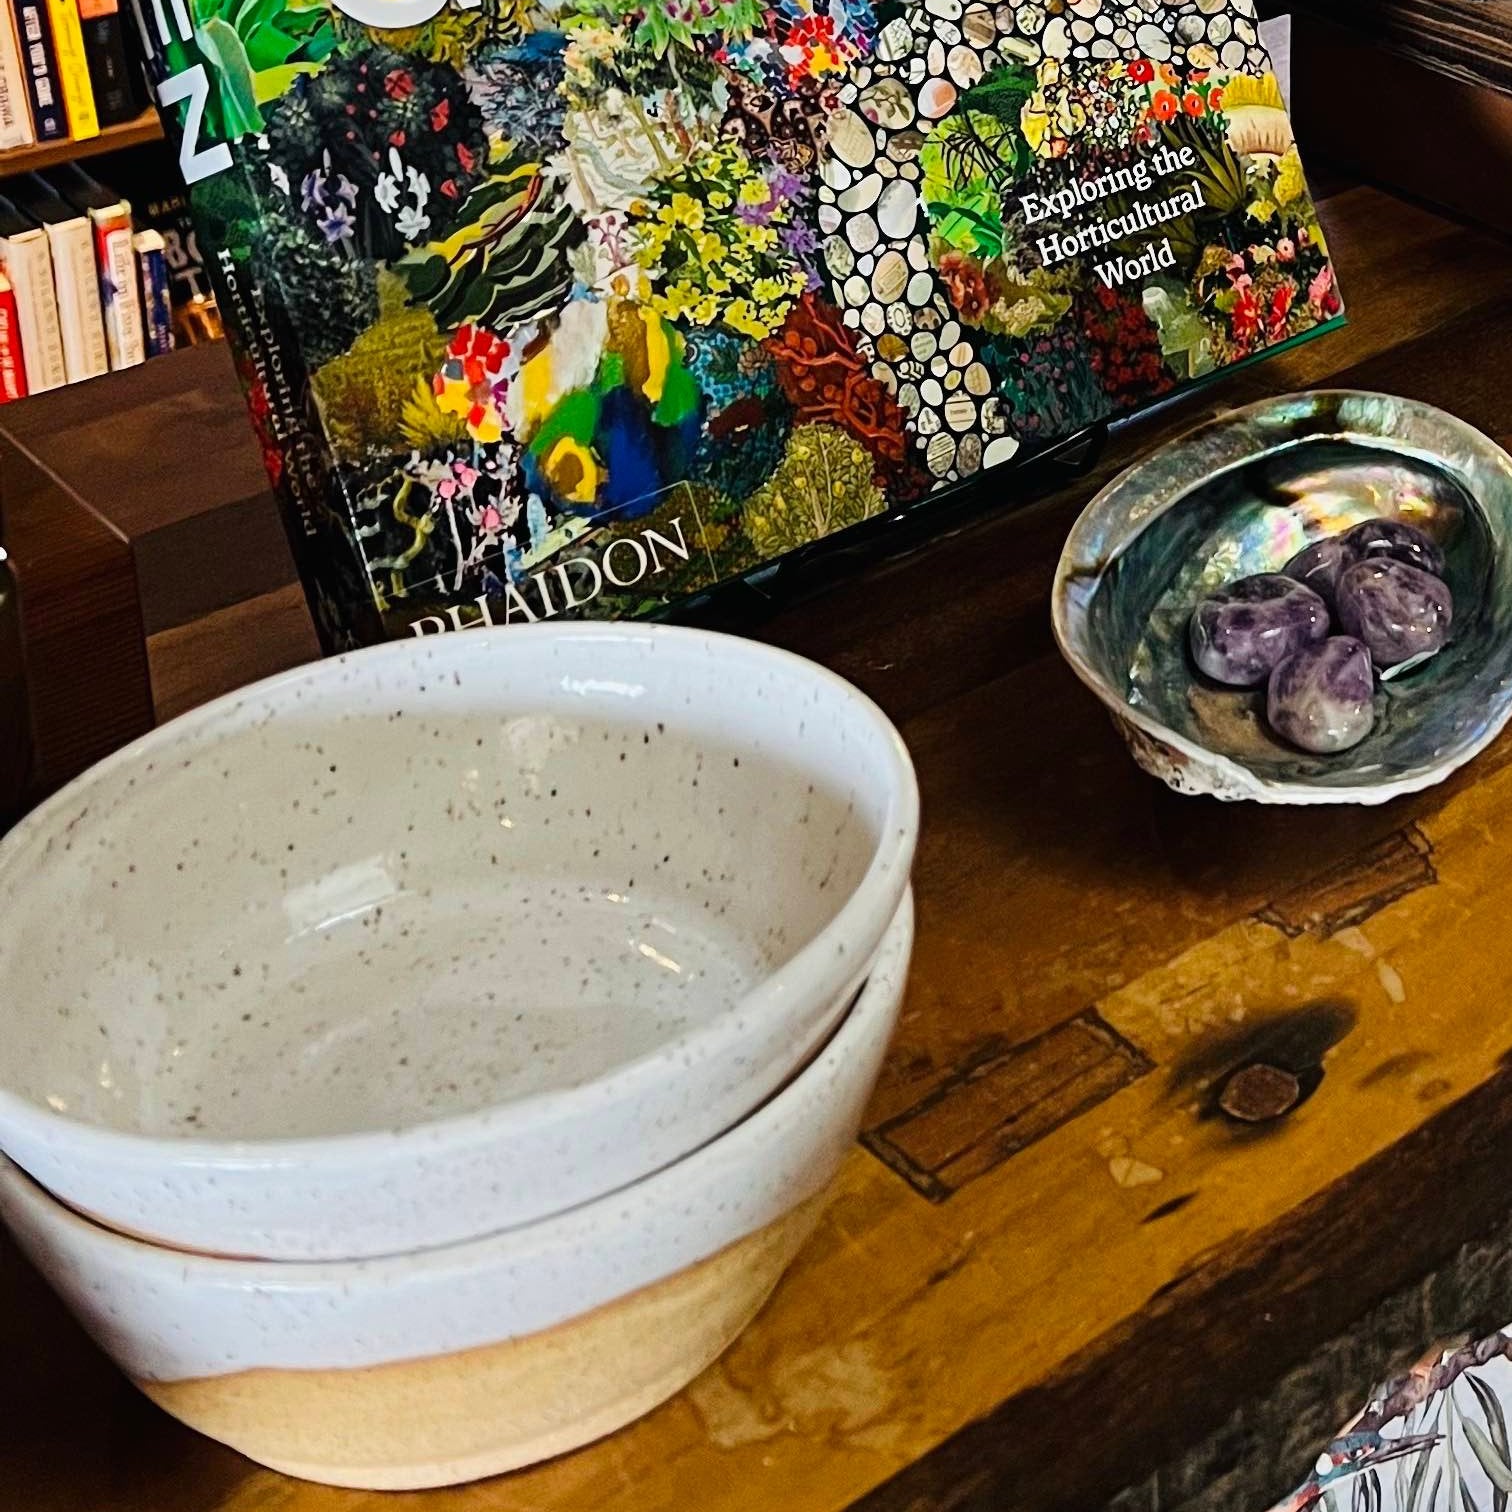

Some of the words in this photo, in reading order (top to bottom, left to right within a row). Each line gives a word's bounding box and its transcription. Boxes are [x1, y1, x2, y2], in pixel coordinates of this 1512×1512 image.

[1018, 159, 1153, 225] Exploring
[1152, 145, 1196, 176] the
[1036, 179, 1206, 267] Horticultural
[1093, 238, 1177, 290] World
[217, 248, 289, 441] Horticultural
[285, 448, 318, 536] World
[250, 288, 301, 435] Exploring
[296, 432, 318, 489] the
